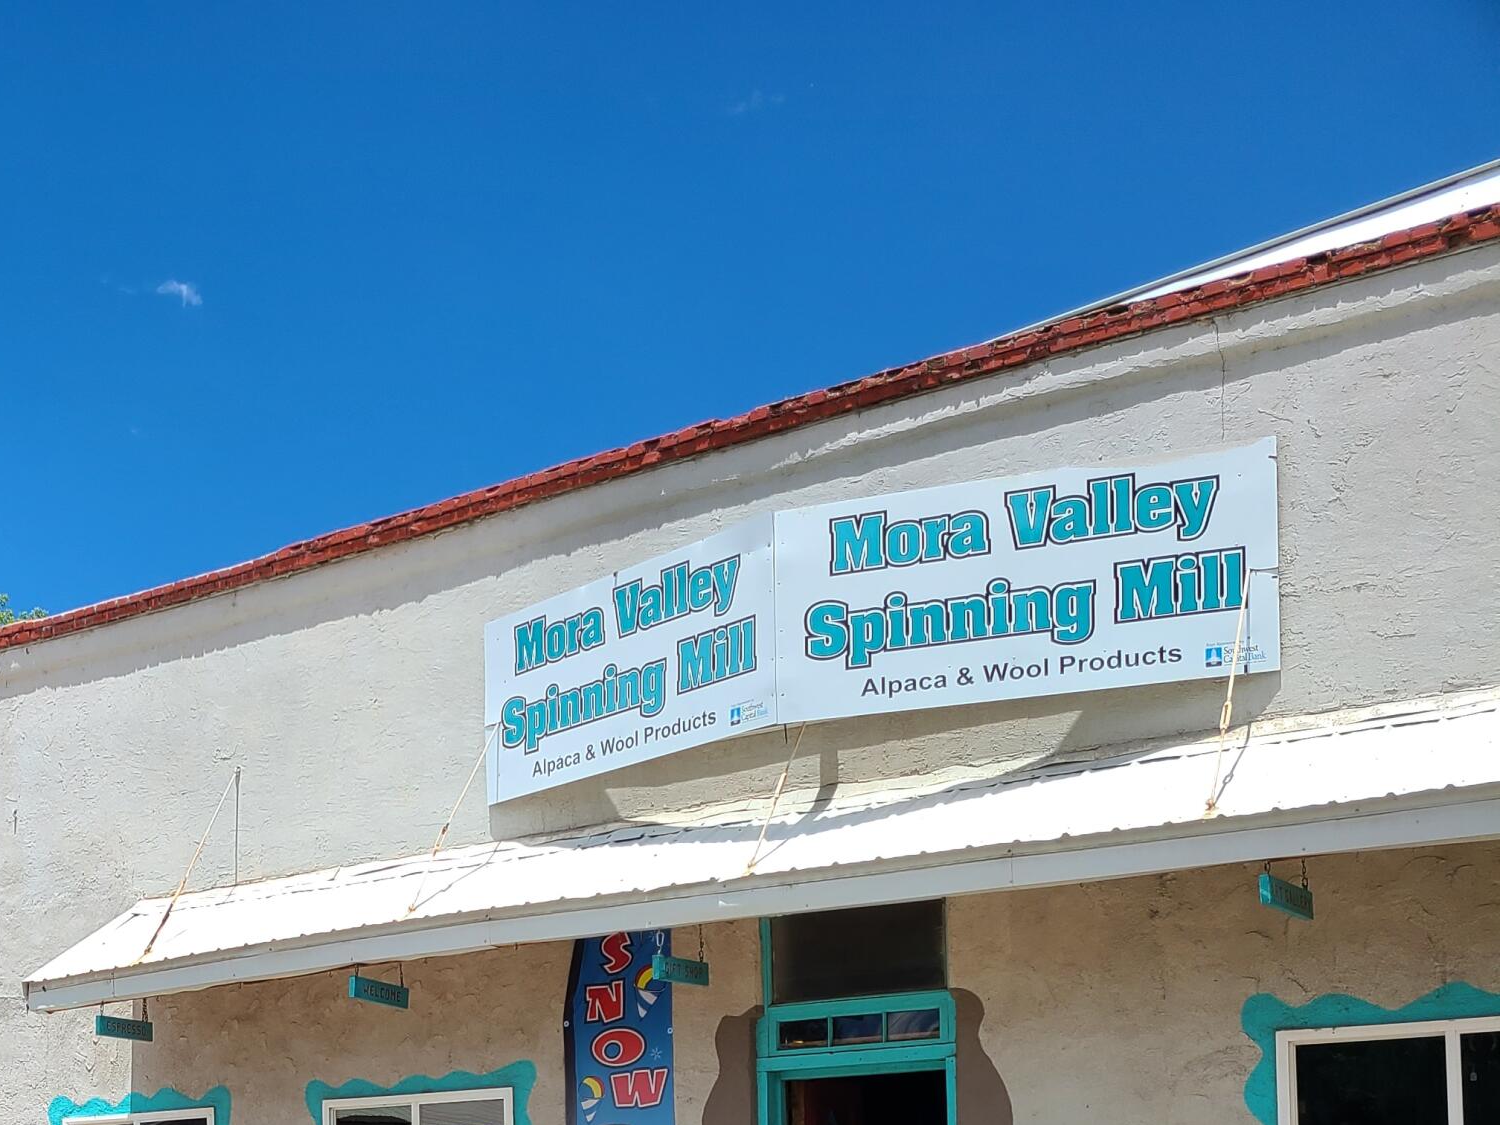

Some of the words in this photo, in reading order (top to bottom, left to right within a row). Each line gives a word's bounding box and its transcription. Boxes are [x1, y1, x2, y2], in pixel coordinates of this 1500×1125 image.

[829, 509, 991, 577] Mora
[1004, 472, 1221, 551] Valley
[514, 606, 605, 676] Mora
[613, 553, 741, 639] Valley
[805, 576, 1097, 671] Spinning
[1113, 545, 1248, 624] Mill
[502, 656, 667, 756] Spinning
[676, 614, 757, 695] Mill
[861, 672, 947, 699] Alpaca
[956, 668, 975, 686] &
[983, 658, 1050, 683] Wool
[1059, 645, 1183, 675] Products
[532, 748, 581, 778] Alpaca
[585, 744, 596, 760] &
[600, 730, 639, 757] Wool
[644, 709, 717, 744] Products
[363, 984, 401, 1002] WELCOME
[664, 962, 681, 977] GIFT
[685, 965, 703, 980] SHOP
[106, 1021, 149, 1037] ESPRESSO
[586, 931, 668, 1108] SNOW
